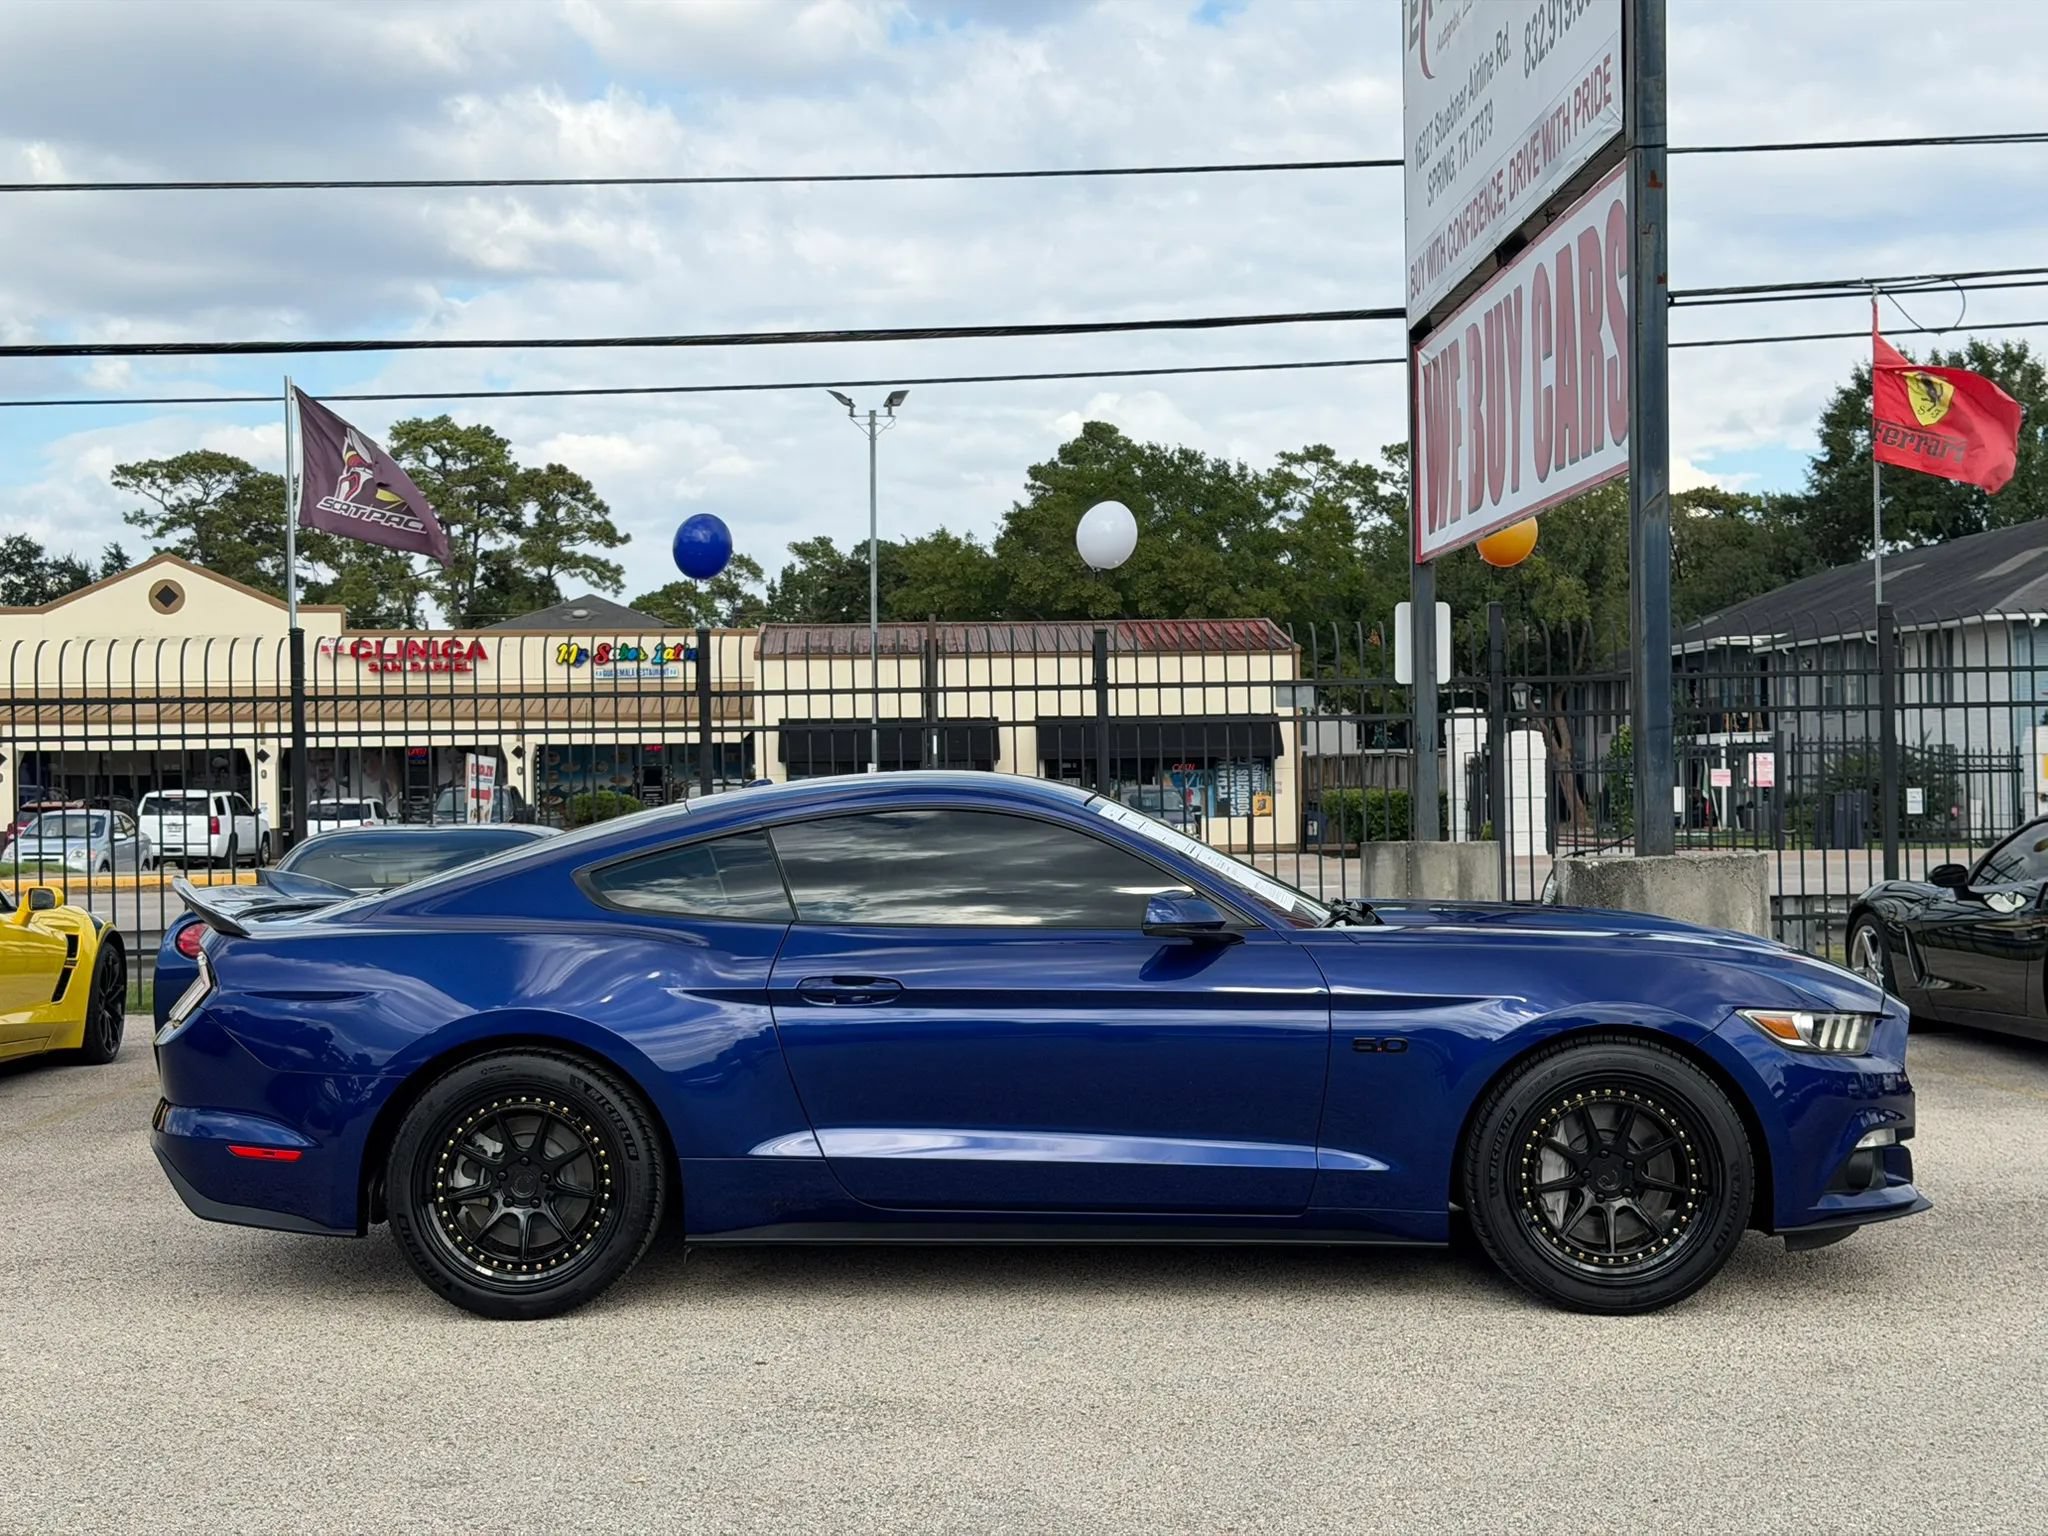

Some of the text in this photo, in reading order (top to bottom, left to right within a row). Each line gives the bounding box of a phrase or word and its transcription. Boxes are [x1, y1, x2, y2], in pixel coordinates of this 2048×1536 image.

[1468, 49, 1493, 107] Airline
[1495, 20, 1511, 73] Rd.
[1524, 0, 1591, 79] 832.919.
[1410, 53, 1612, 302] BUY WITH CONFIDENCE, DRIVE WITH PRIDE
[1427, 98, 1493, 208] SPRING, TX 77379
[1423, 199, 1628, 535] WE BUY CARS
[350, 639, 489, 661] CLINICA
[368, 661, 402, 673] SAN
[556, 642, 699, 668] My Sabor Latin
[1352, 1036, 1409, 1053] 5.0
[586, 1087, 640, 1157] MICHELIN
[1488, 1111, 1516, 1179] MICHELIN
